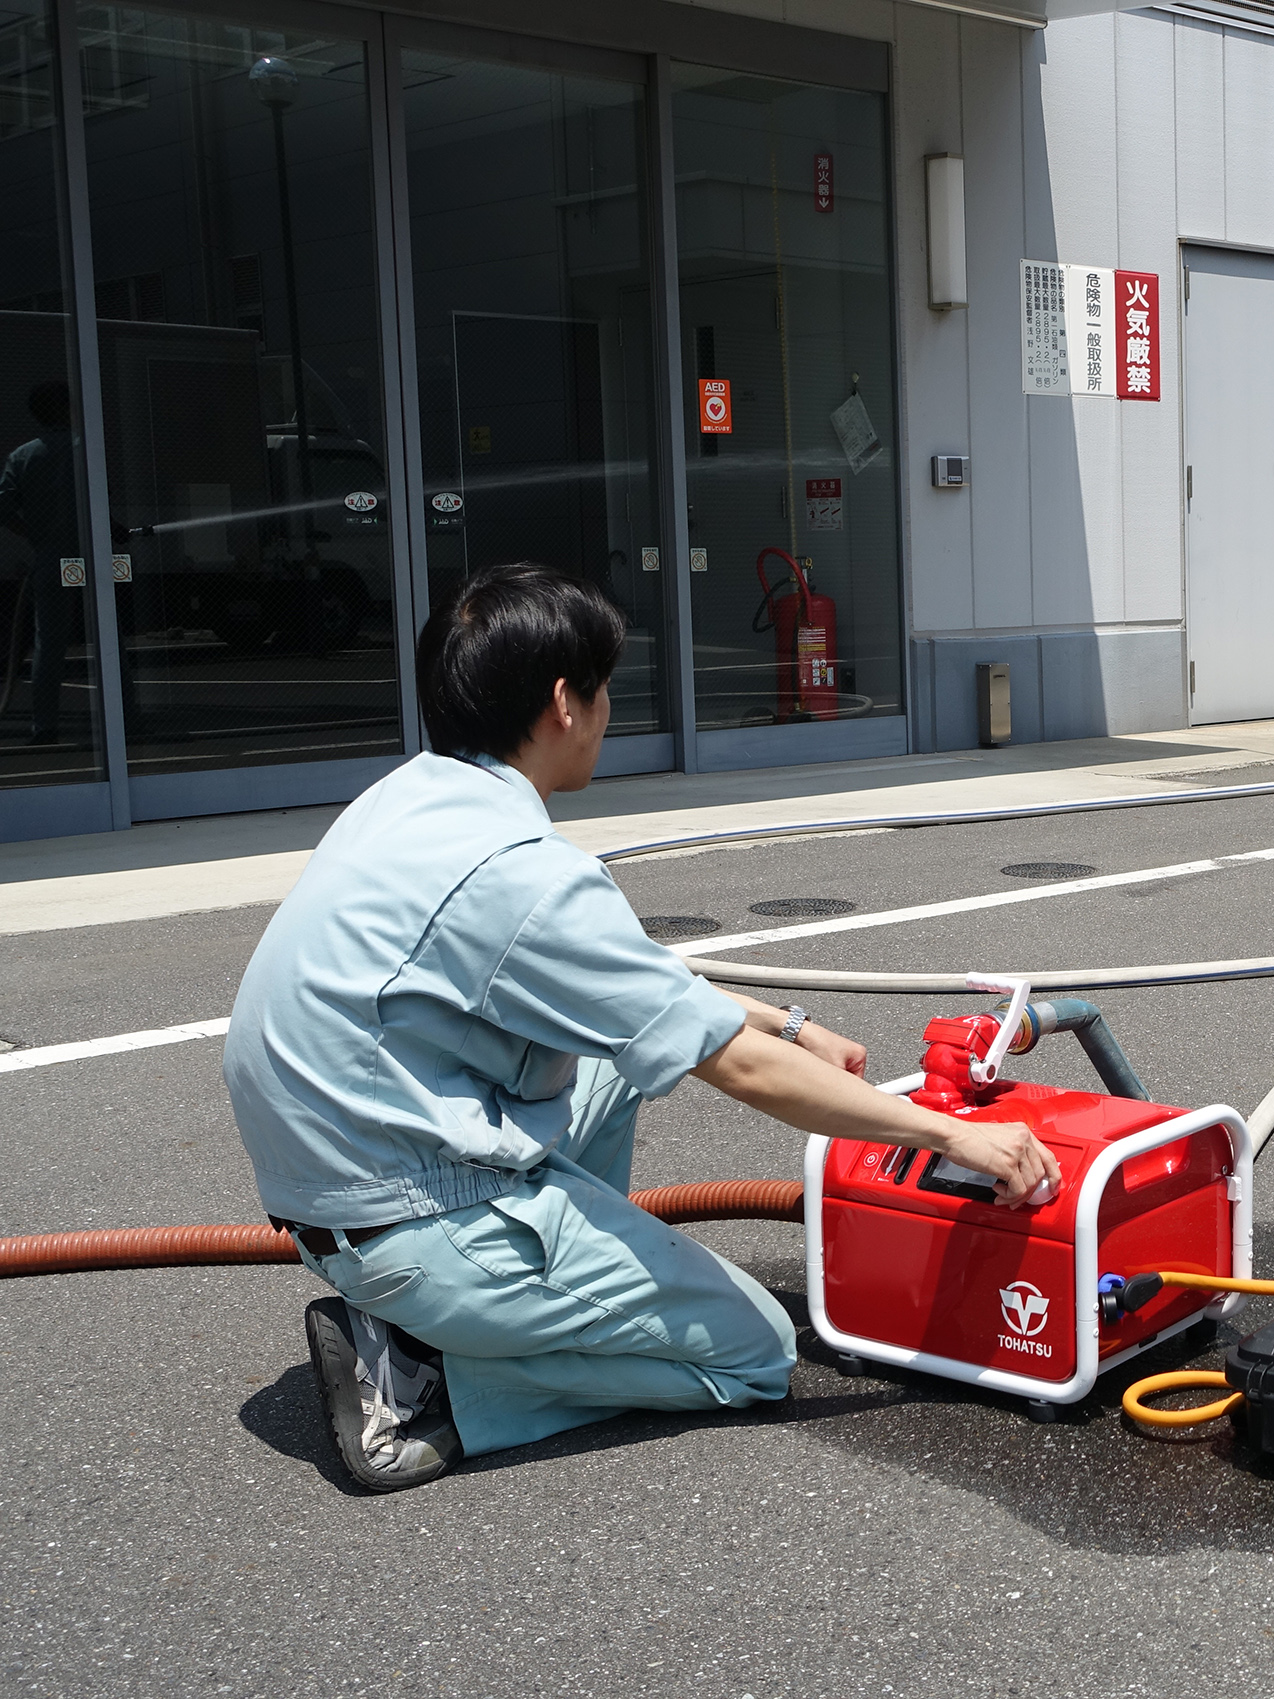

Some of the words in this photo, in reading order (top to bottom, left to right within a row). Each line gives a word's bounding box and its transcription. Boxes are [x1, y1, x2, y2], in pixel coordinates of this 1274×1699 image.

[817, 157, 829, 196] 消火器
[1085, 273, 1102, 391] 危険物一般取扱所
[1125, 279, 1151, 394] 火気厳禁
[704, 382, 726, 392] AED
[997, 1334, 1052, 1358] TOHATSU
